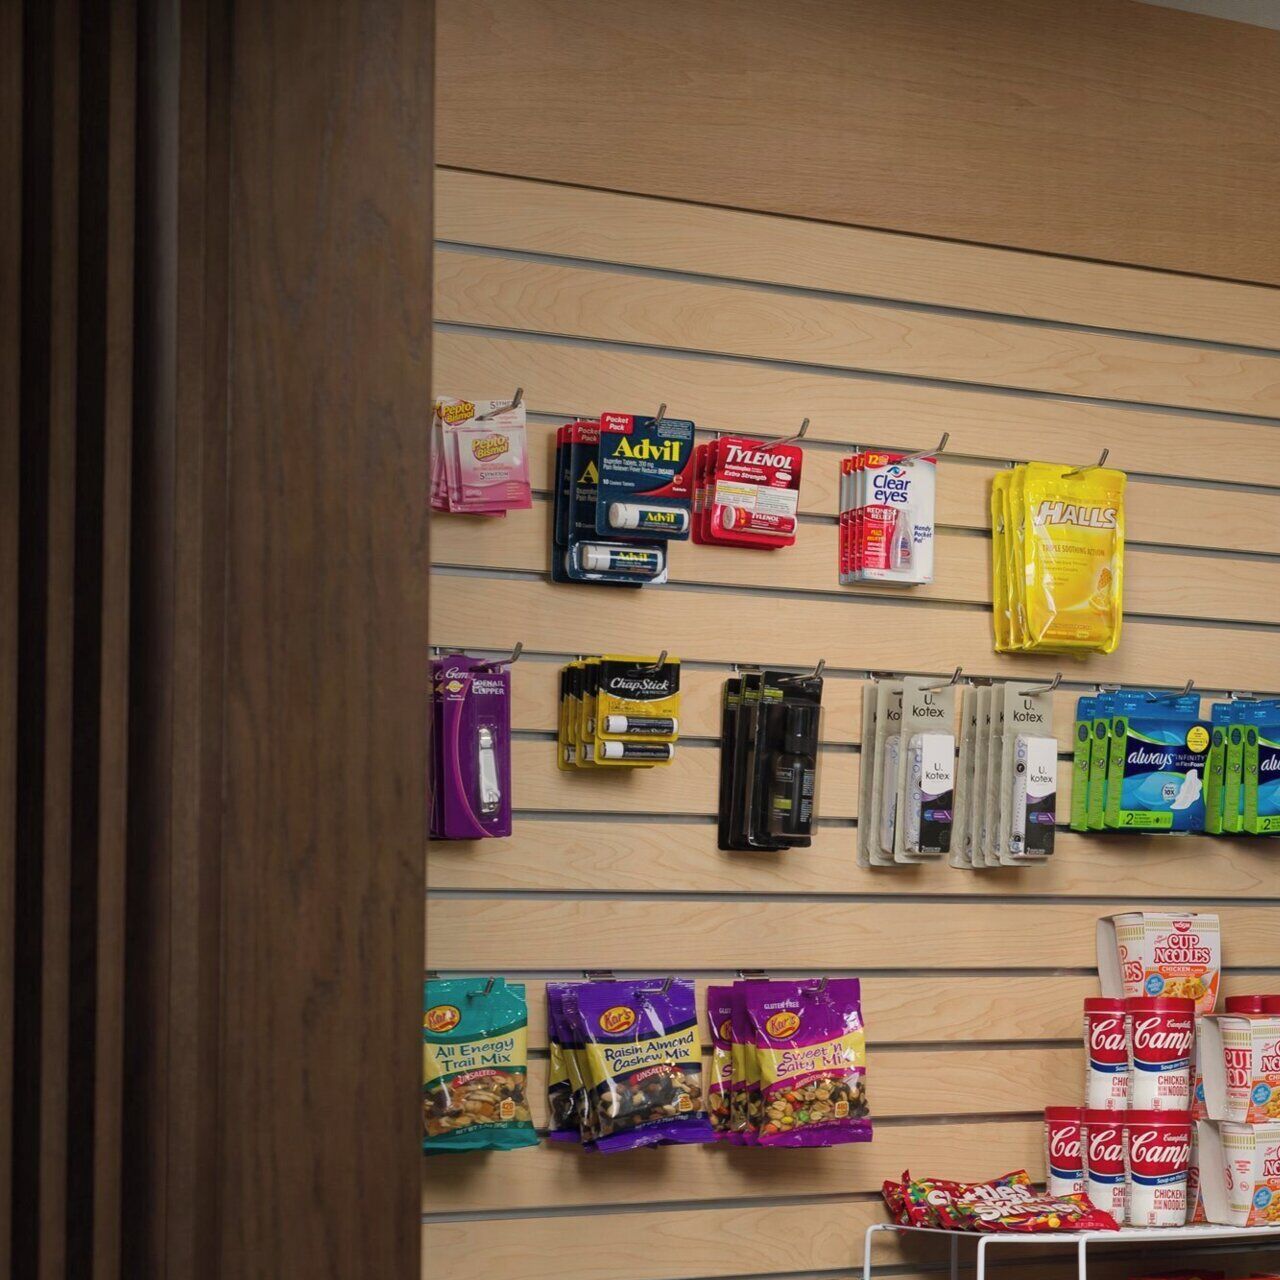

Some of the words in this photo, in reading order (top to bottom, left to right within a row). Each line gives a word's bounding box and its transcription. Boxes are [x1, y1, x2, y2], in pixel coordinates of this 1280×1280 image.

[605, 415, 629, 424] Pocket
[609, 423, 625, 431] Pack
[612, 436, 683, 462] Advil
[725, 444, 792, 469] TYLENOL
[741, 472, 767, 481] Strength
[873, 474, 911, 490] Clear
[874, 489, 908, 505] eyes
[646, 512, 676, 523] Advil
[1035, 500, 1118, 529] HALLS
[617, 552, 649, 562] Advil
[445, 666, 468, 679] Gem
[610, 676, 669, 691] ChapStick
[912, 706, 944, 718] kotex
[1013, 709, 1043, 723] kotex
[1127, 747, 1174, 770] always
[925, 771, 949, 780] kotex
[1030, 773, 1054, 784] kotex
[1168, 934, 1199, 949] CUP
[1154, 947, 1211, 964] NOODLES
[604, 1010, 632, 1026] Kar's
[435, 1044, 455, 1059] All
[460, 1038, 514, 1056] Energy
[605, 1047, 643, 1061] Raisin
[646, 1032, 695, 1053] Almond
[442, 1058, 475, 1072] Trail
[481, 1053, 512, 1065] Mix
[613, 1052, 663, 1072] Cashew
[665, 1047, 690, 1063] Mix
[782, 1047, 828, 1064] Sweet
[776, 1060, 815, 1077] Salty
[1158, 1075, 1185, 1085] CHICKEN
[1154, 1189, 1183, 1199] CHICKEN
